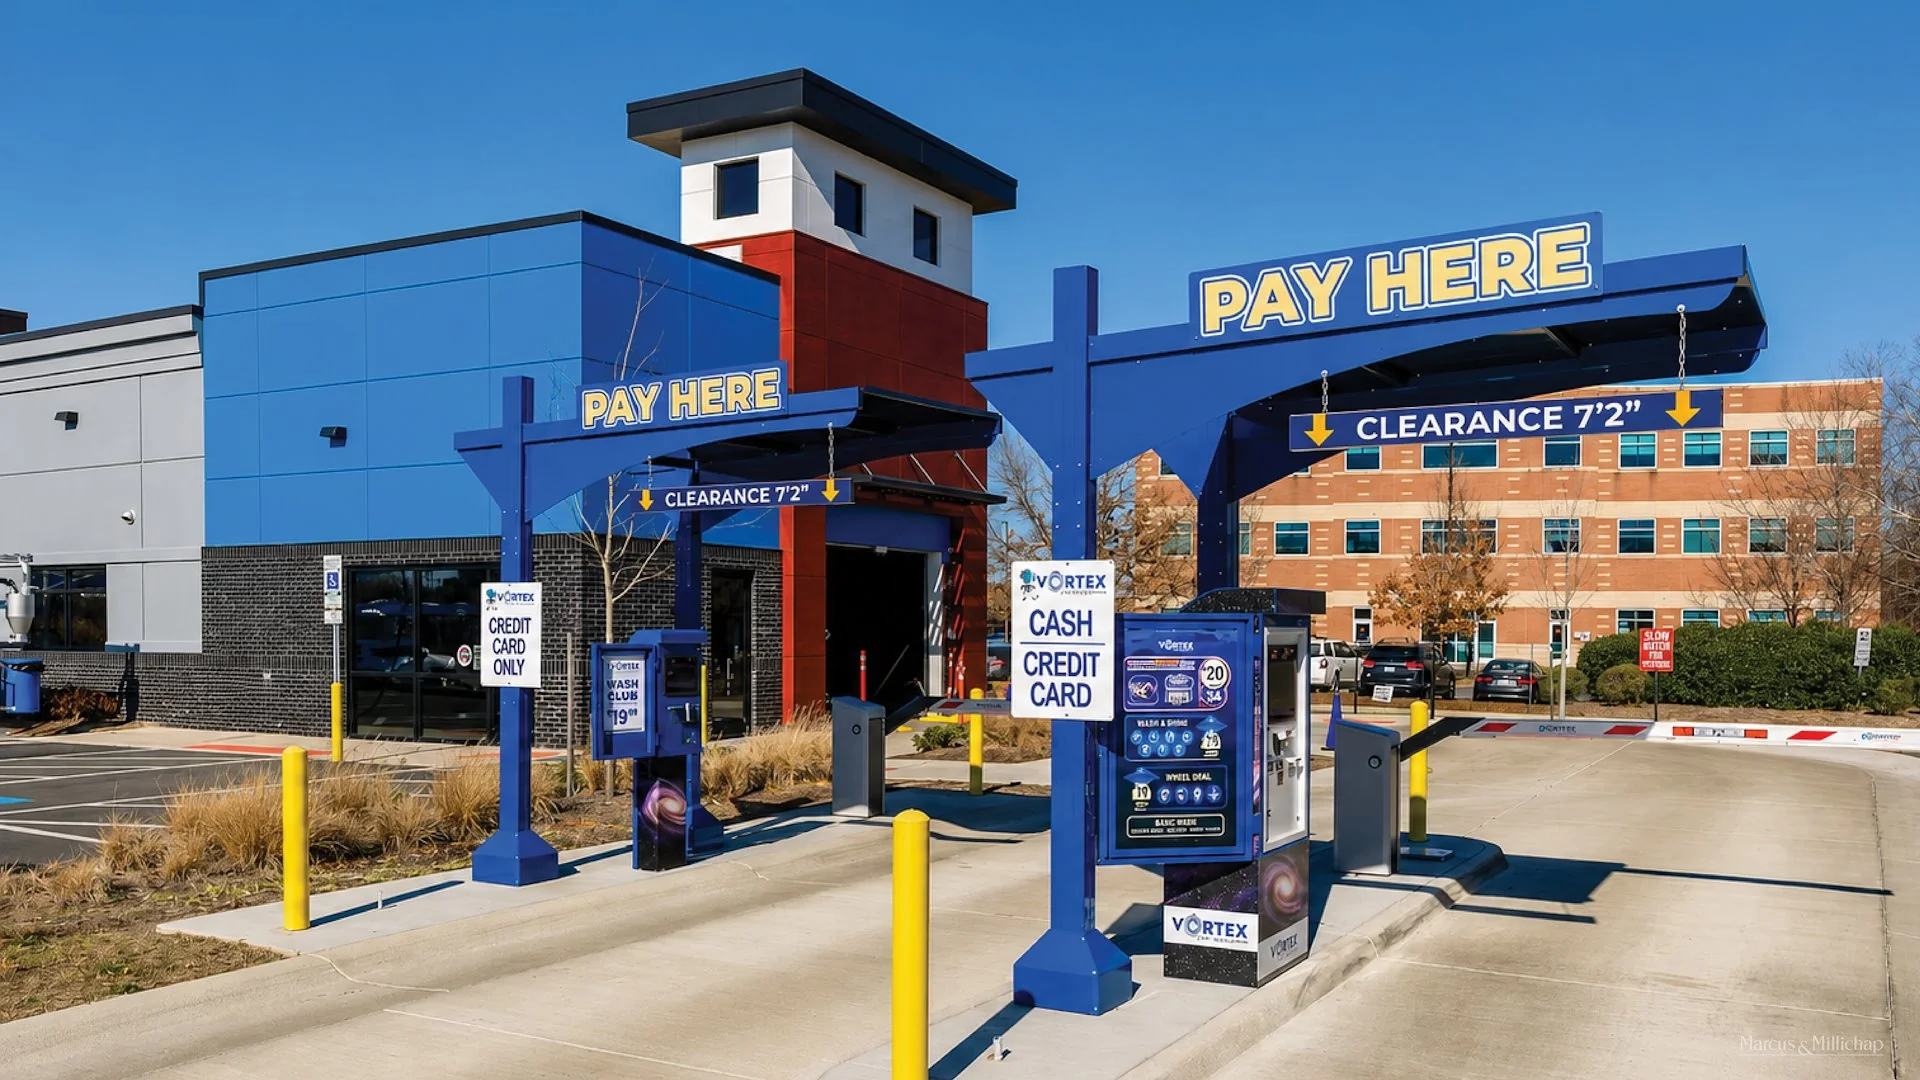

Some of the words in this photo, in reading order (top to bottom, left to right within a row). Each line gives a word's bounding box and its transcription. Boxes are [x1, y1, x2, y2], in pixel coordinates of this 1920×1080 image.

[1200, 256, 1352, 337] PAY
[1367, 222, 1591, 315] HERE
[582, 382, 662, 430] PAY
[669, 367, 781, 420] HERE
[1356, 405, 1563, 441] CLEARANCE
[665, 487, 770, 508] CLEARANCE
[1037, 571, 1106, 592] VORTEX
[497, 591, 534, 604] VORTEX
[489, 617, 532, 634] CREDIT
[1029, 609, 1093, 636] CASH
[492, 638, 525, 654] CARD
[1643, 632, 1670, 641] SLOW
[493, 658, 525, 675] ONLY
[1023, 651, 1100, 677] CREDIT
[607, 680, 638, 689] WASH
[1030, 681, 1092, 708] CARD
[608, 691, 638, 700] CLUB
[1172, 914, 1248, 938] VORTEX
